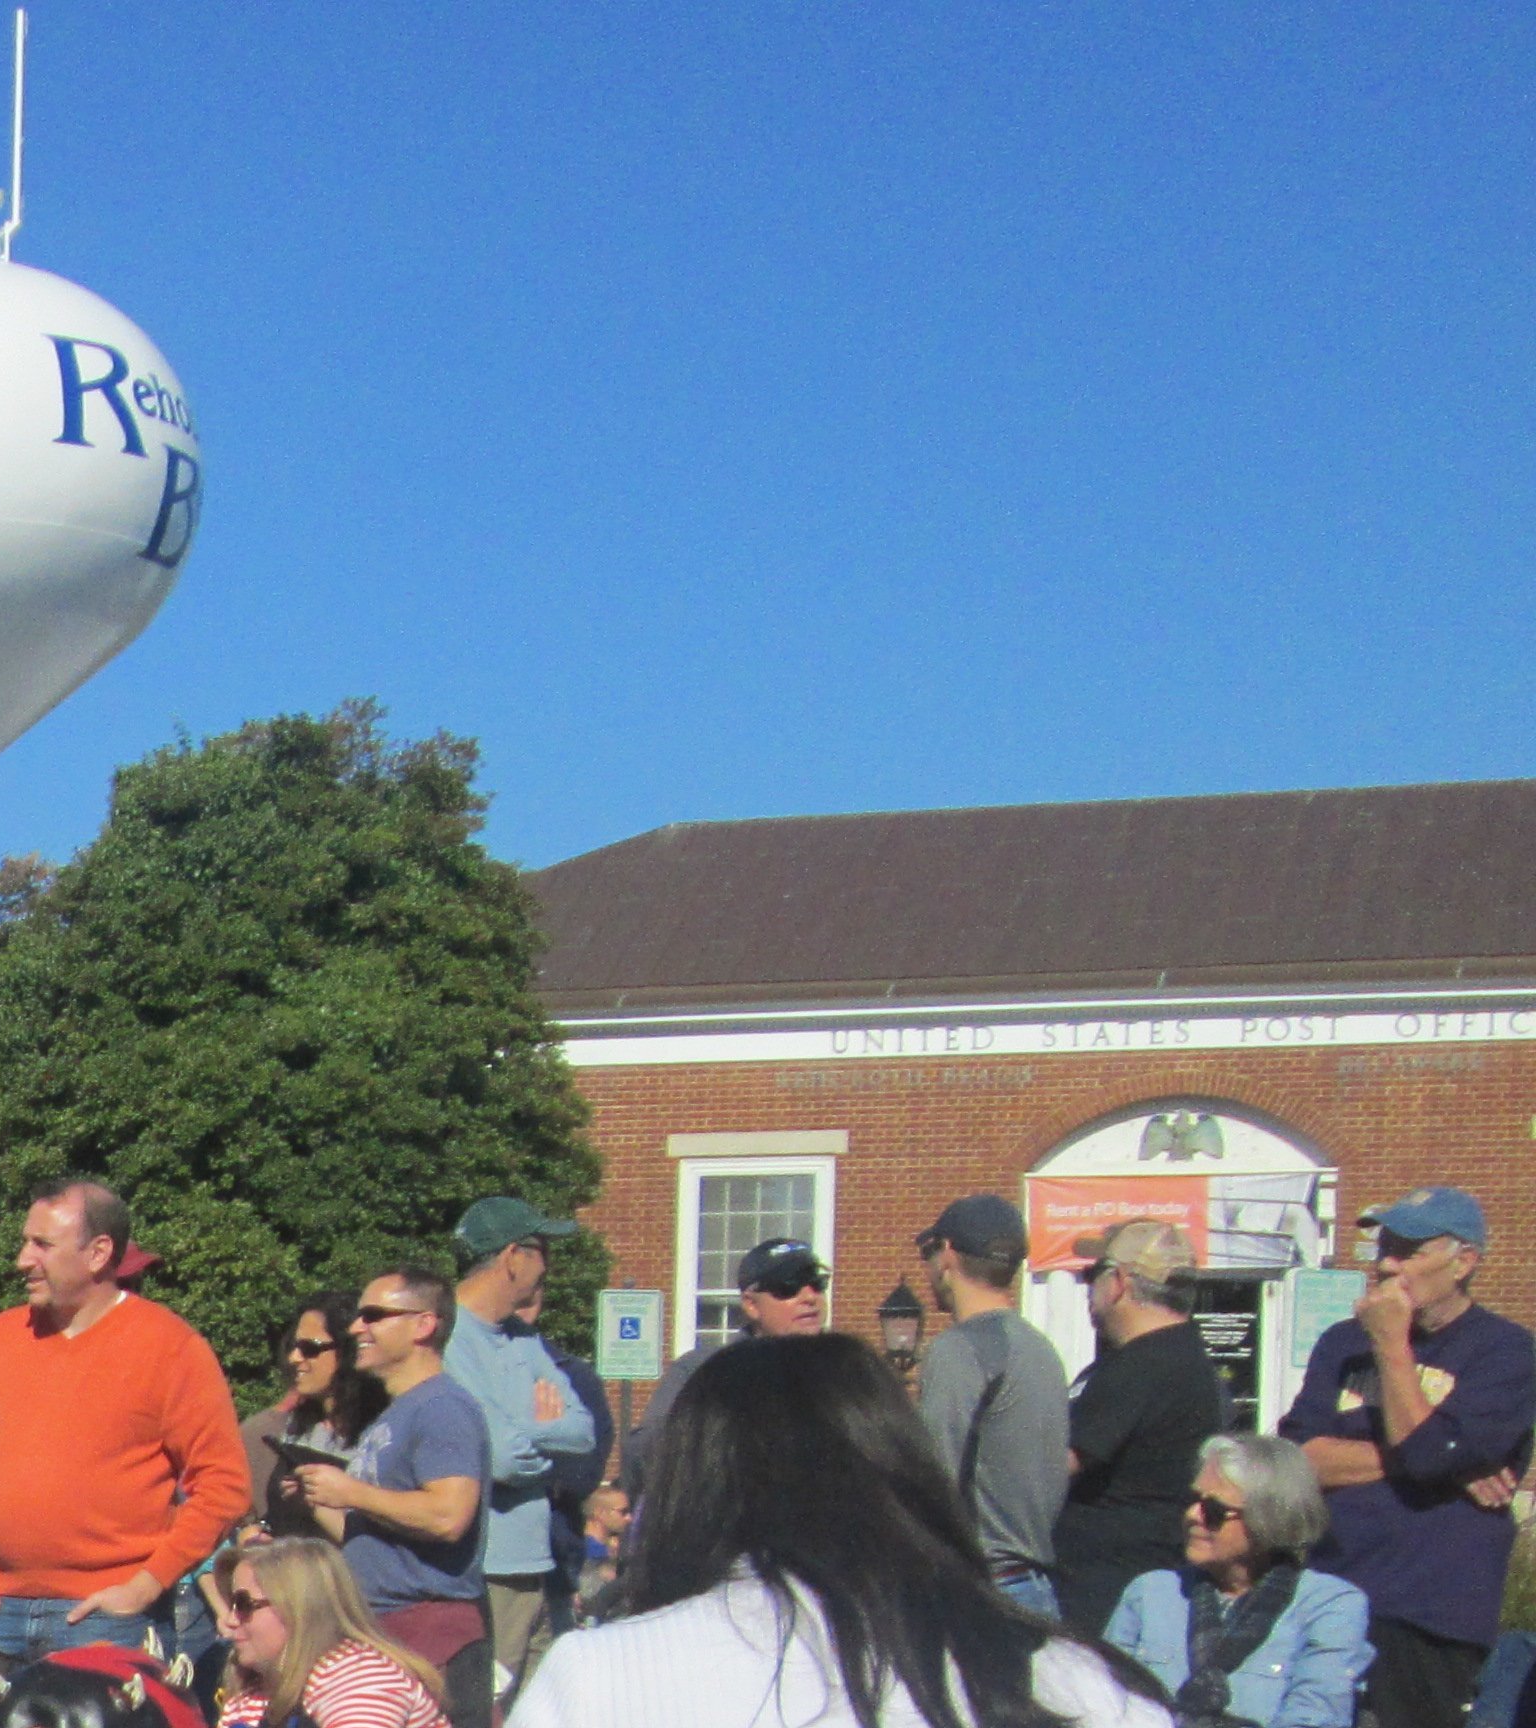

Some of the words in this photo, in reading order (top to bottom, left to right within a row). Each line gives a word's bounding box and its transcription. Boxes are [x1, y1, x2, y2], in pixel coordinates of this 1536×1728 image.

[41, 333, 198, 458] Reho
[831, 1026, 995, 1054] UNITED
[1042, 1020, 1191, 1048] STATES
[1240, 1016, 1340, 1042] POST
